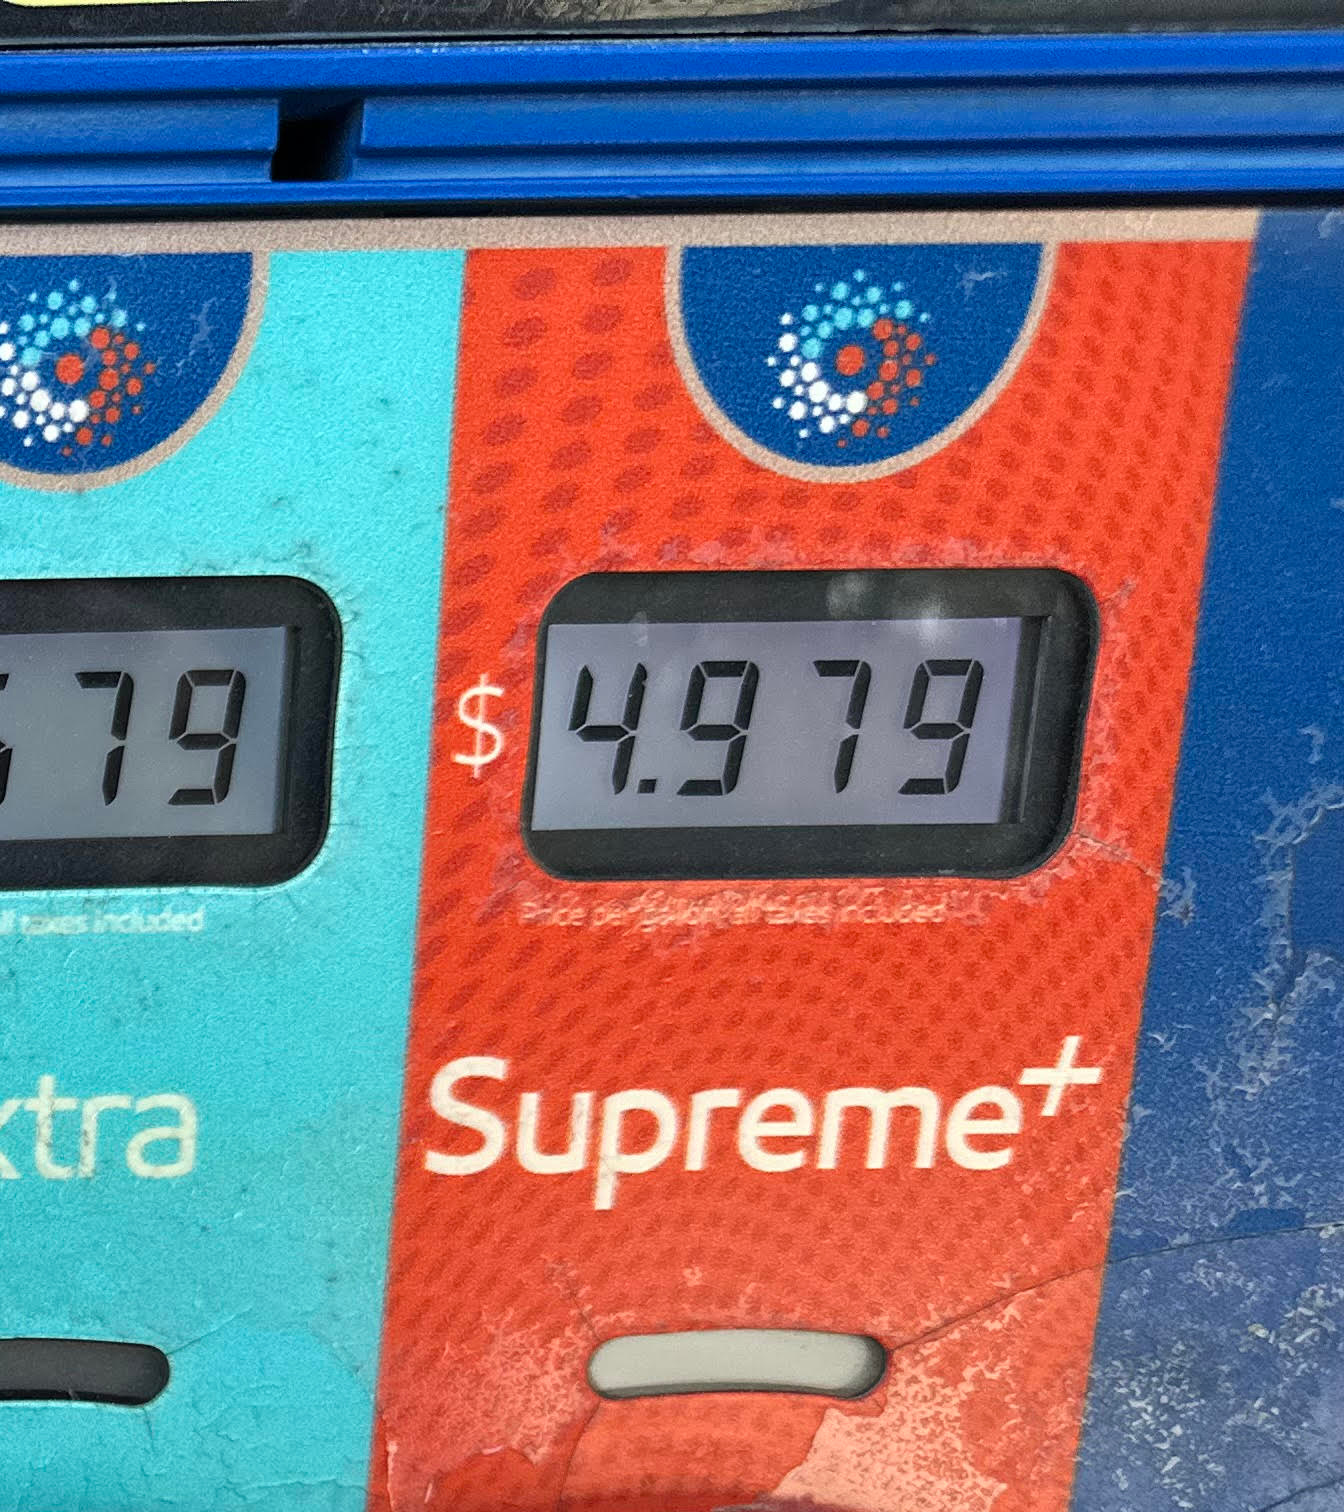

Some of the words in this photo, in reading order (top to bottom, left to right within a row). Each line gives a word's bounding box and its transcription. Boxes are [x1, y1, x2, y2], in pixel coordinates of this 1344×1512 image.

[454, 674, 506, 779] $
[568, 658, 984, 796] 4.979
[21, 913, 88, 937] taxes
[94, 908, 205, 935] included
